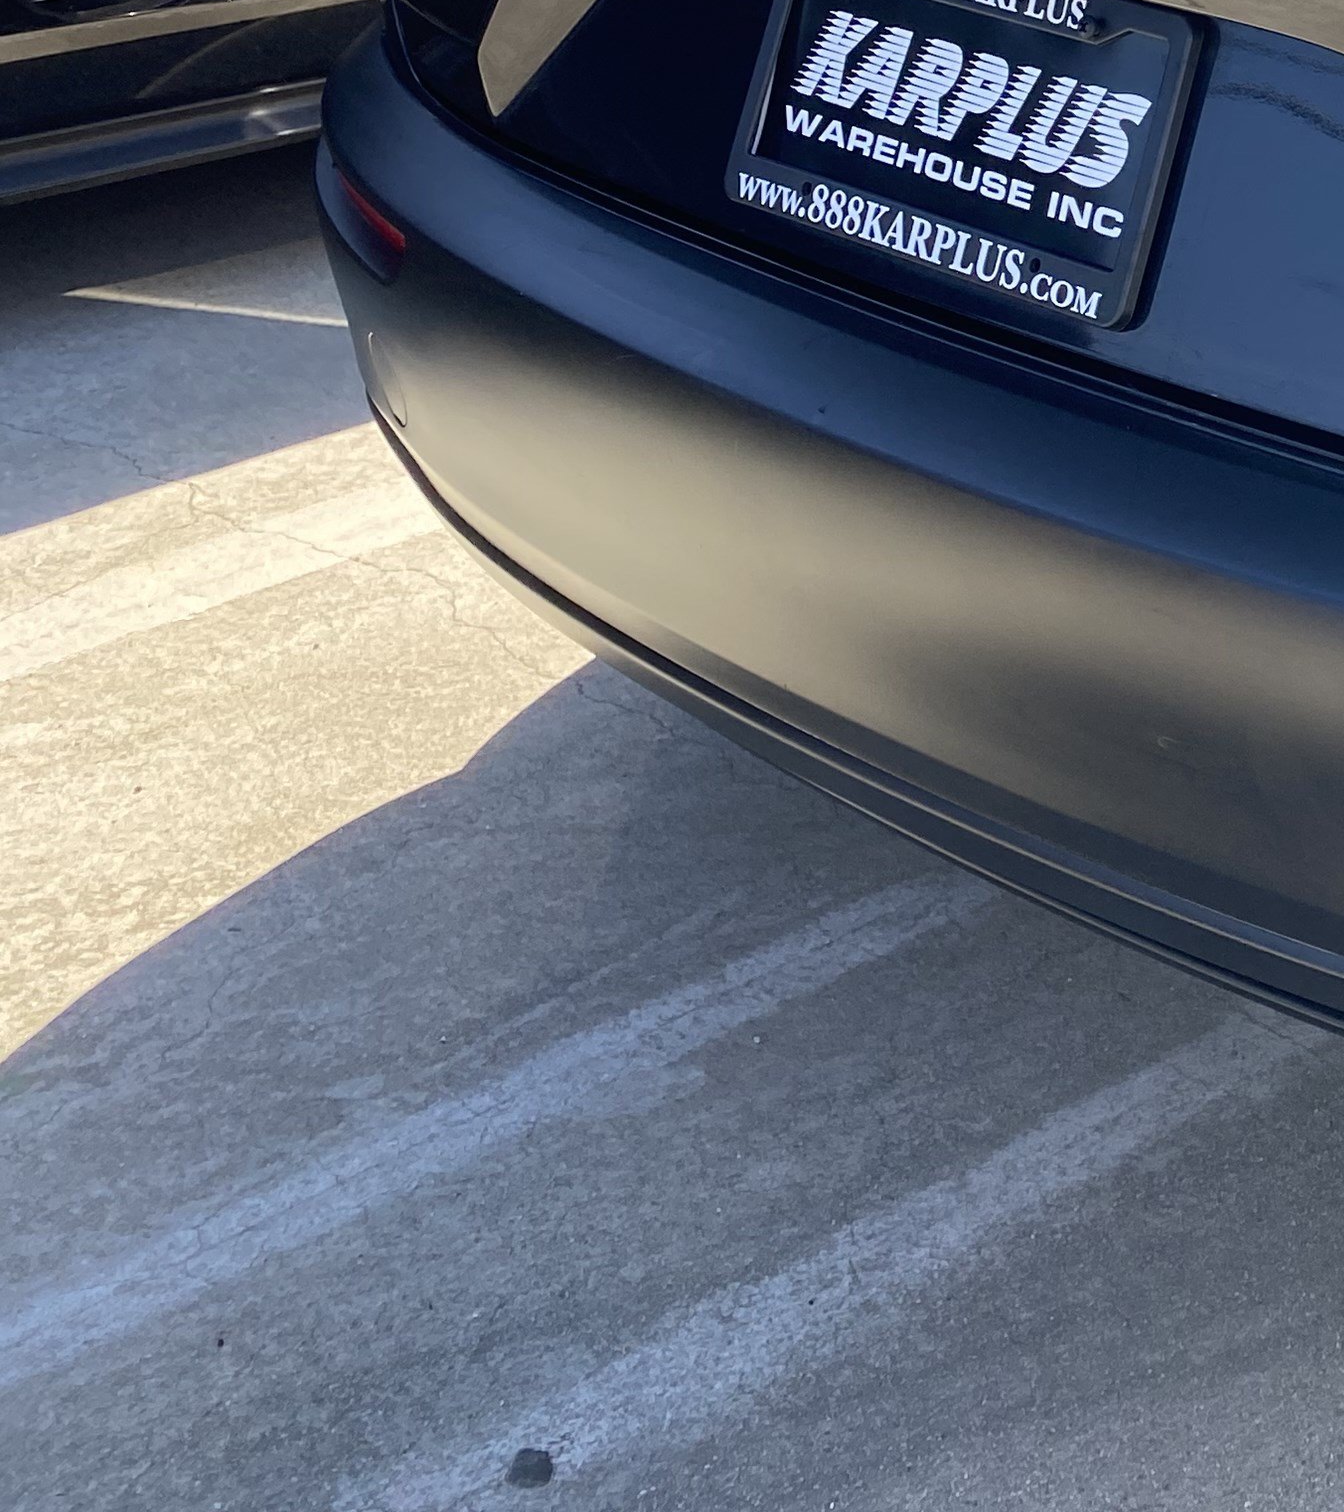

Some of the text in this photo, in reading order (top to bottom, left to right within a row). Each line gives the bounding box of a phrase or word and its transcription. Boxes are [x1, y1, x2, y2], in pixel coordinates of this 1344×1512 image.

[784, 104, 1125, 240] WAREHOUSE INC
[790, 9, 1153, 189] KARPLUS
